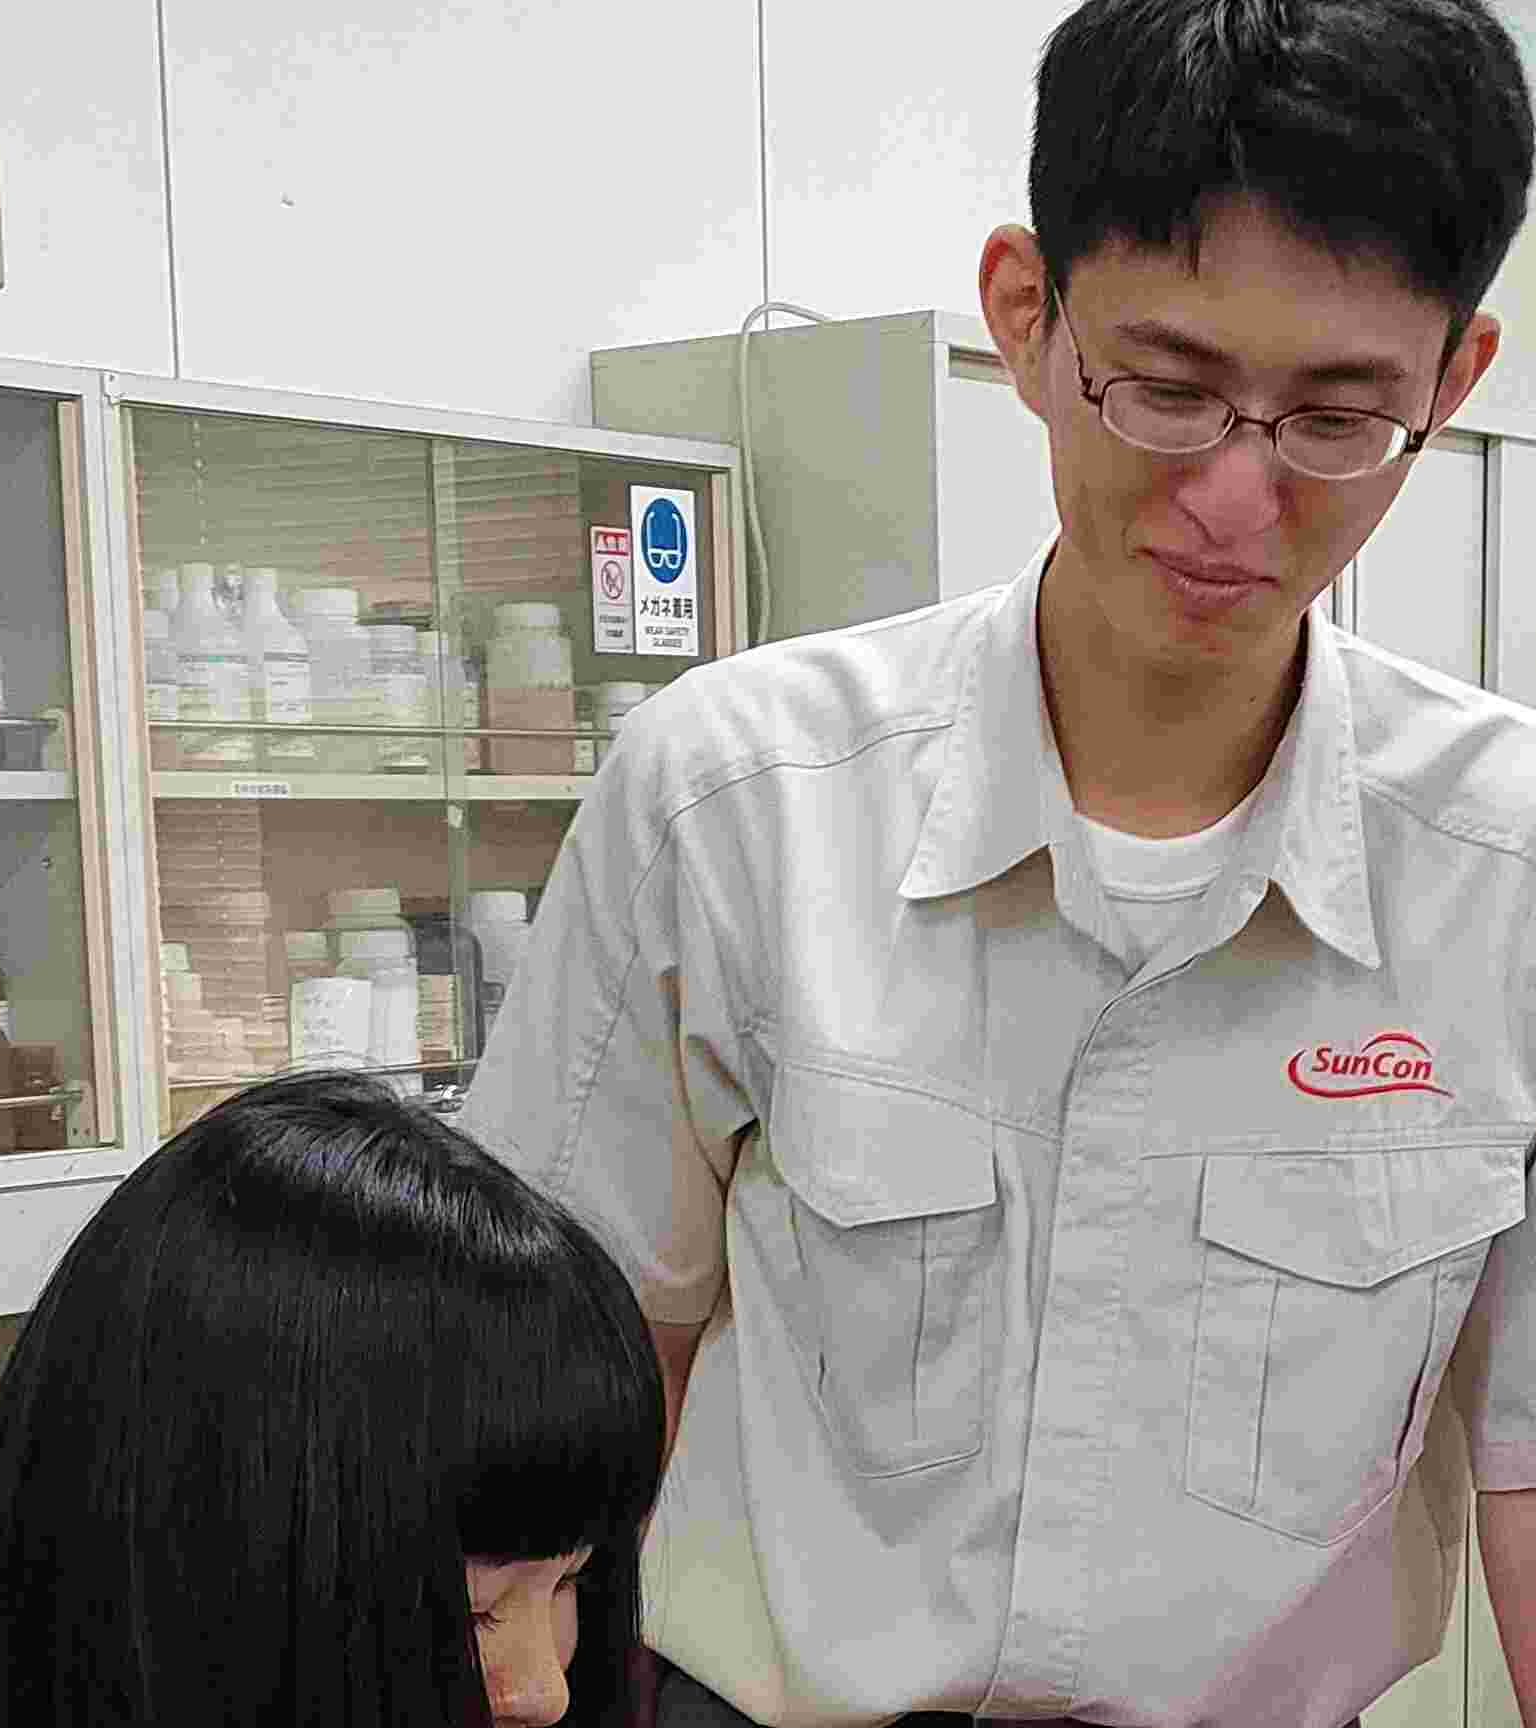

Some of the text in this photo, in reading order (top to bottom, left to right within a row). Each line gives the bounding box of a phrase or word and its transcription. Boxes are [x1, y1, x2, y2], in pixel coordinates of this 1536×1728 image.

[640, 597, 693, 620] メガネ着用
[1312, 1047, 1432, 1081] SunCon
